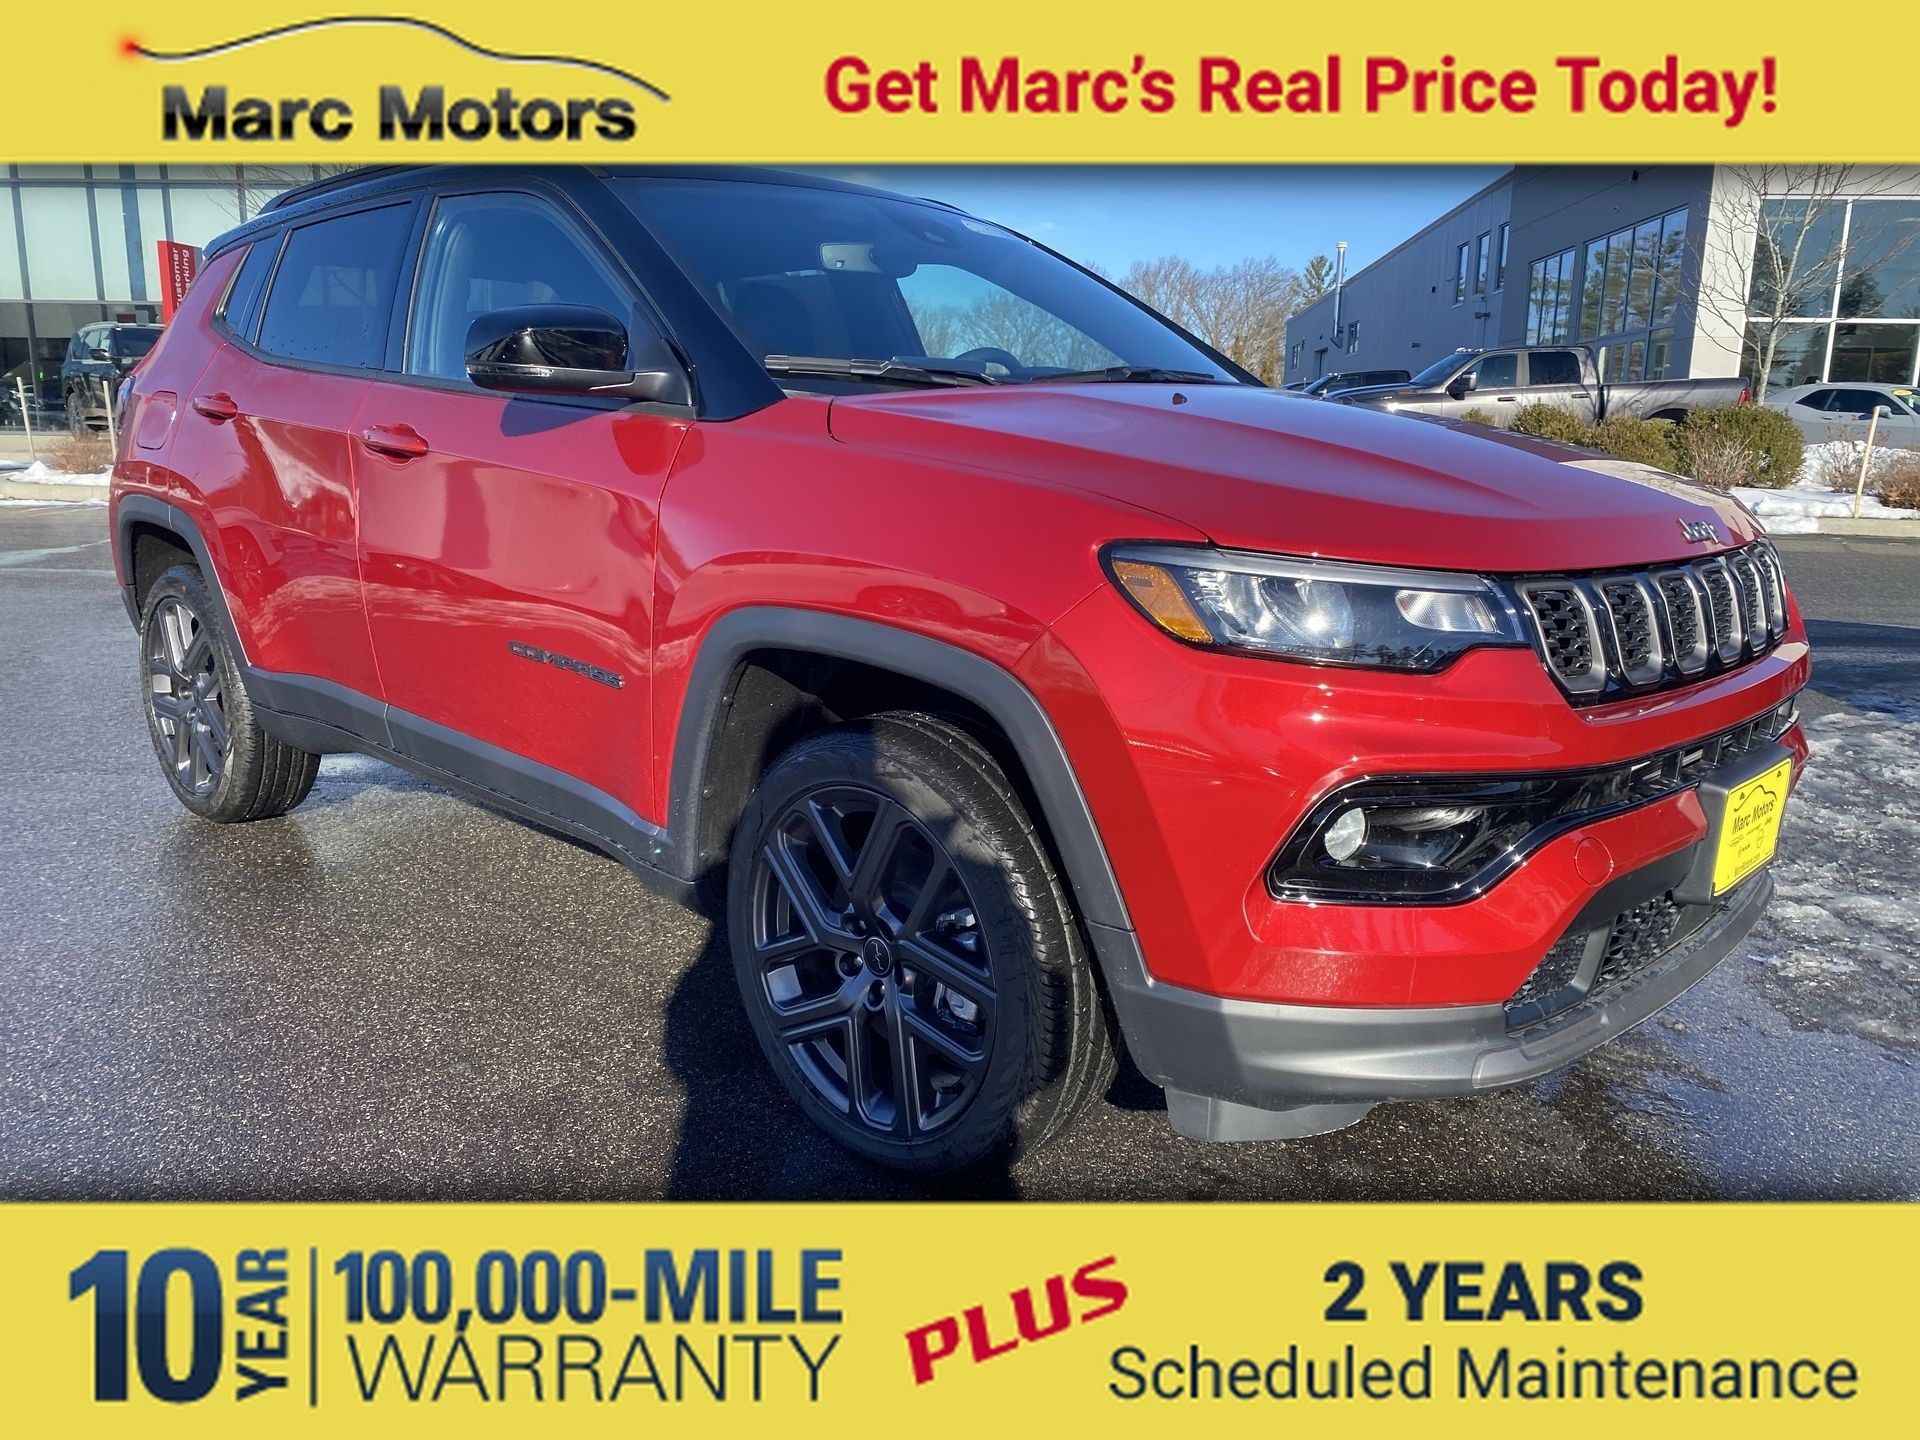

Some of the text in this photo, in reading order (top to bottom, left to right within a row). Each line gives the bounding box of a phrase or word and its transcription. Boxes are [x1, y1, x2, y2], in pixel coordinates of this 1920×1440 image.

[182, 249, 191, 293] arking
[508, 641, 624, 690] COMPASS
[1732, 814, 1751, 835] Marc
[1752, 799, 1775, 823] Motors
